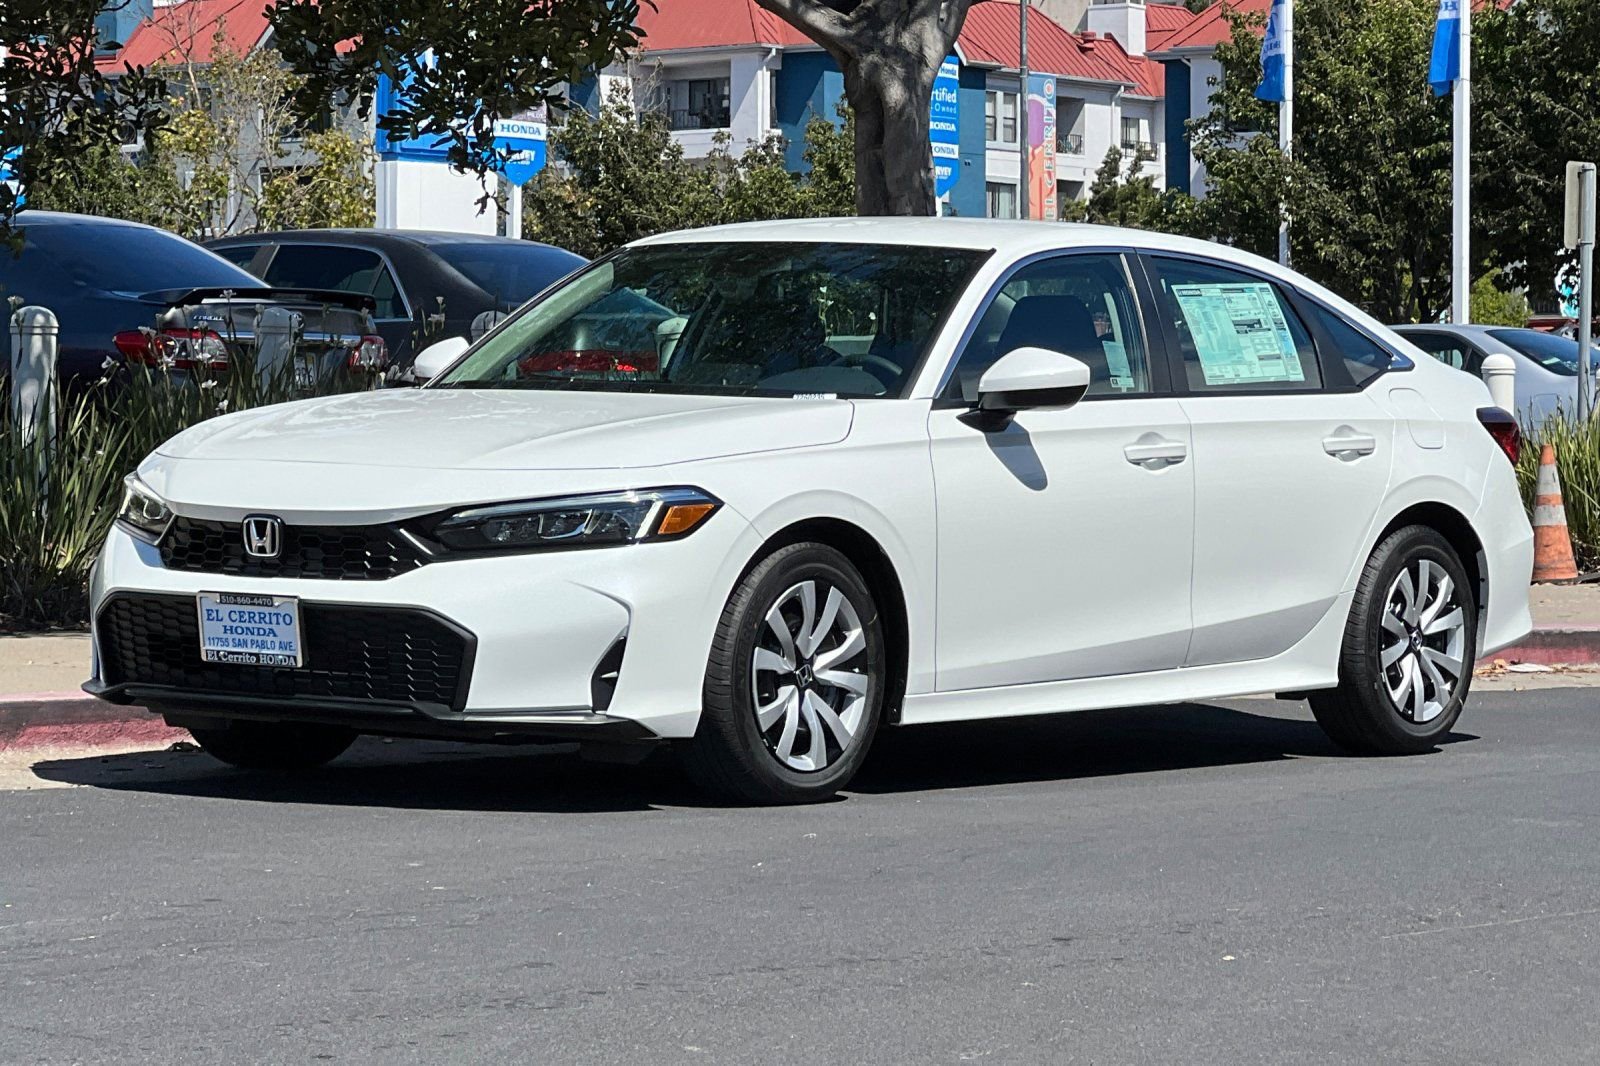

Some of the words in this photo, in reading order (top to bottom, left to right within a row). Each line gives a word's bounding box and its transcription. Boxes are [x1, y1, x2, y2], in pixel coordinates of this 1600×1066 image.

[931, 87, 957, 104] rtified
[500, 124, 541, 135] HONDA
[1044, 79, 1054, 187] CERRITO
[934, 145, 956, 156] ONDA
[206, 609, 223, 622] EL
[228, 610, 293, 626] CERRITO
[222, 625, 278, 637] HONDA
[208, 636, 230, 648] 11755
[232, 637, 248, 649] SAN
[250, 639, 276, 651] PABLO
[207, 650, 218, 661] El
[219, 651, 257, 664] Cerrito
[259, 655, 297, 667] HONDA
